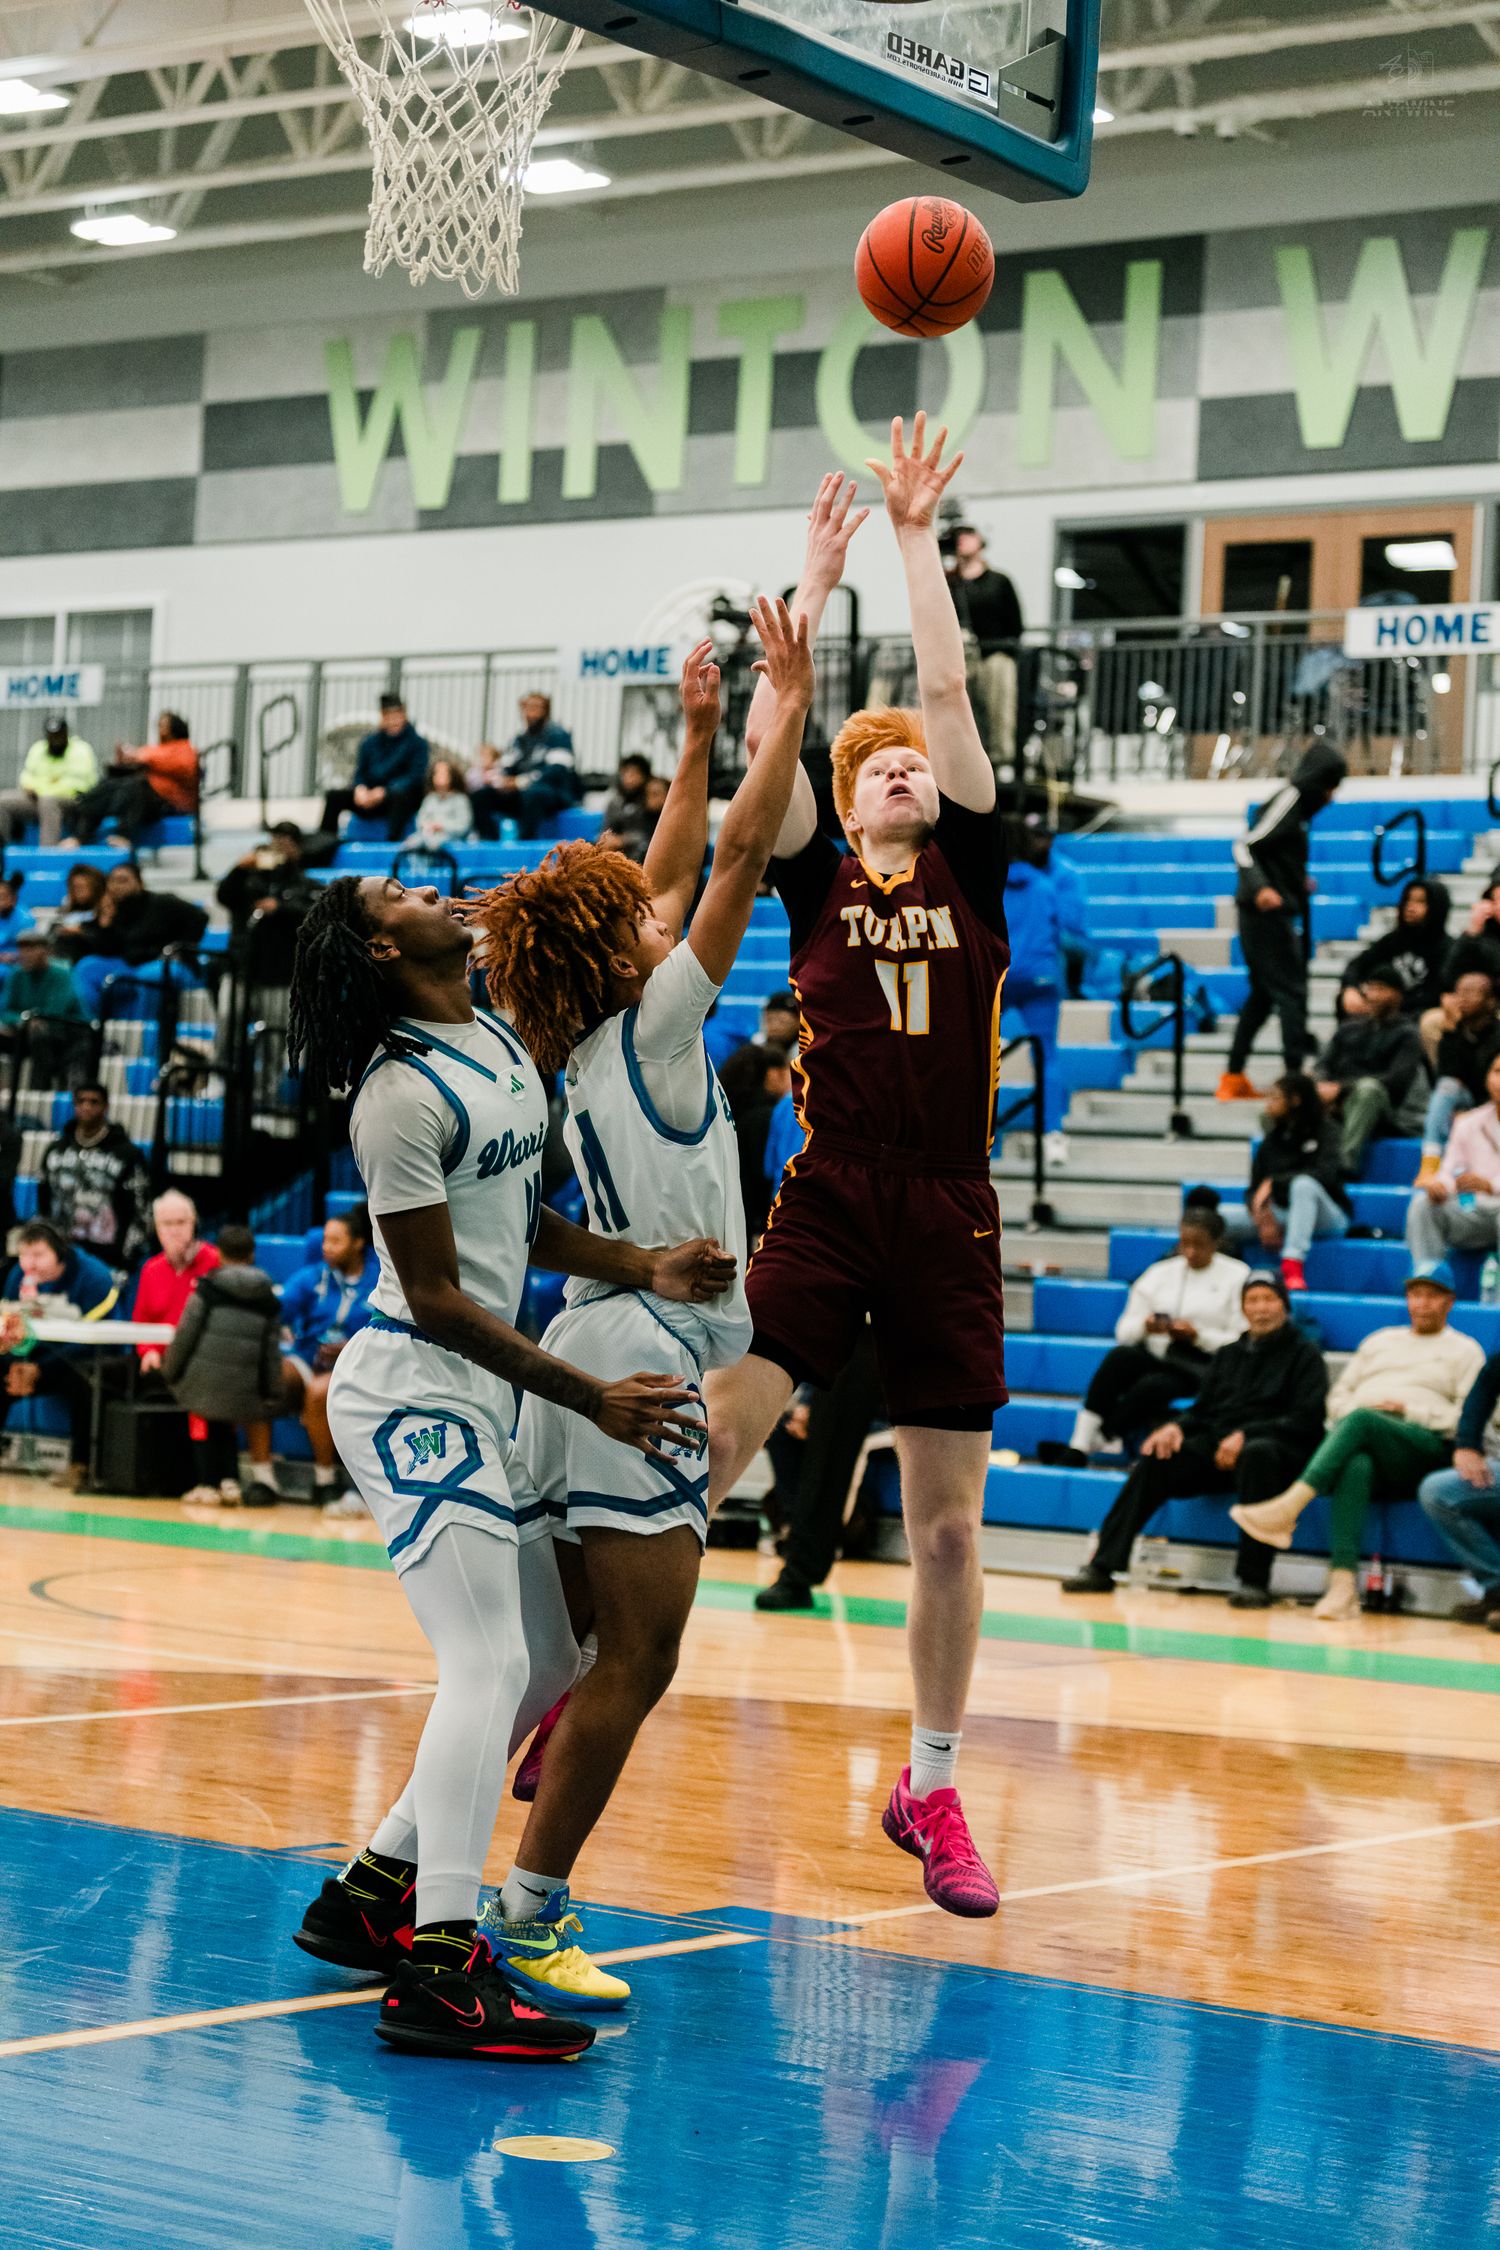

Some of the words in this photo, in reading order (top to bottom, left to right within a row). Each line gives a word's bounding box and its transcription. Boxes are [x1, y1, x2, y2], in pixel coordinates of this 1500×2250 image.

[323, 259, 1164, 514] WINTON
[1274, 227, 1491, 450] W
[1376, 612, 1492, 646] HOME
[579, 645, 671, 678] HOME
[7, 671, 81, 700] HOME
[874, 959, 930, 1036] 11
[476, 1121, 545, 1180] Warri
